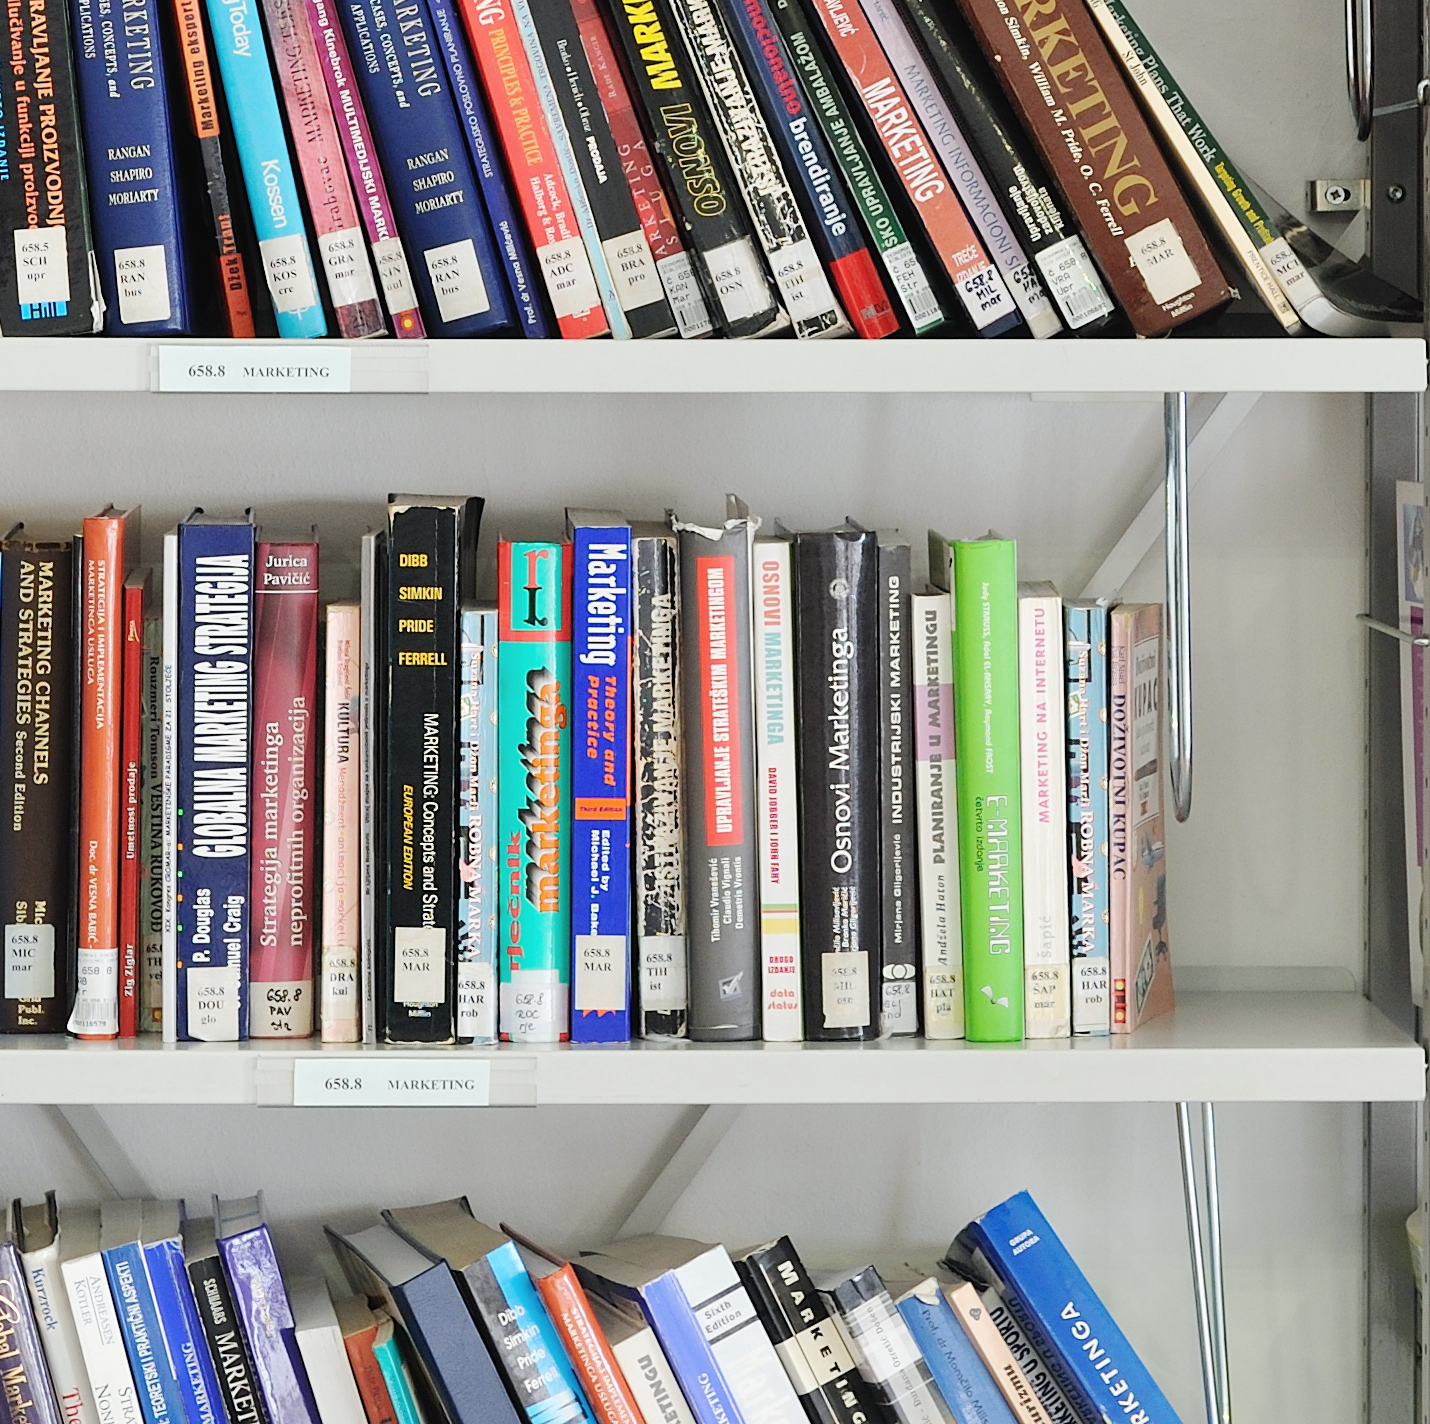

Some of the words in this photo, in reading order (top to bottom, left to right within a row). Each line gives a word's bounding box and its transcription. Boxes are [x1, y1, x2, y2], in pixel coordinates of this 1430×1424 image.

[261, 159, 289, 228] Kossen
[788, 117, 848, 237] brendiranje
[189, 365, 225, 377] 658.8
[243, 367, 330, 378] MARKETING
[34, 560, 54, 675] MARKETING
[578, 543, 627, 666] Marketing
[33, 680, 53, 785] CHANNELS
[829, 626, 852, 770] Marketinga
[829, 783, 852, 873] Osnovi
[985, 794, 1011, 956] E-MARKETING
[325, 1078, 362, 1090] 658.8
[388, 1080, 474, 1090] MARKETING
[30, 1268, 57, 1331] Kurzrock
[202, 1278, 227, 1324] SCHNAARS
